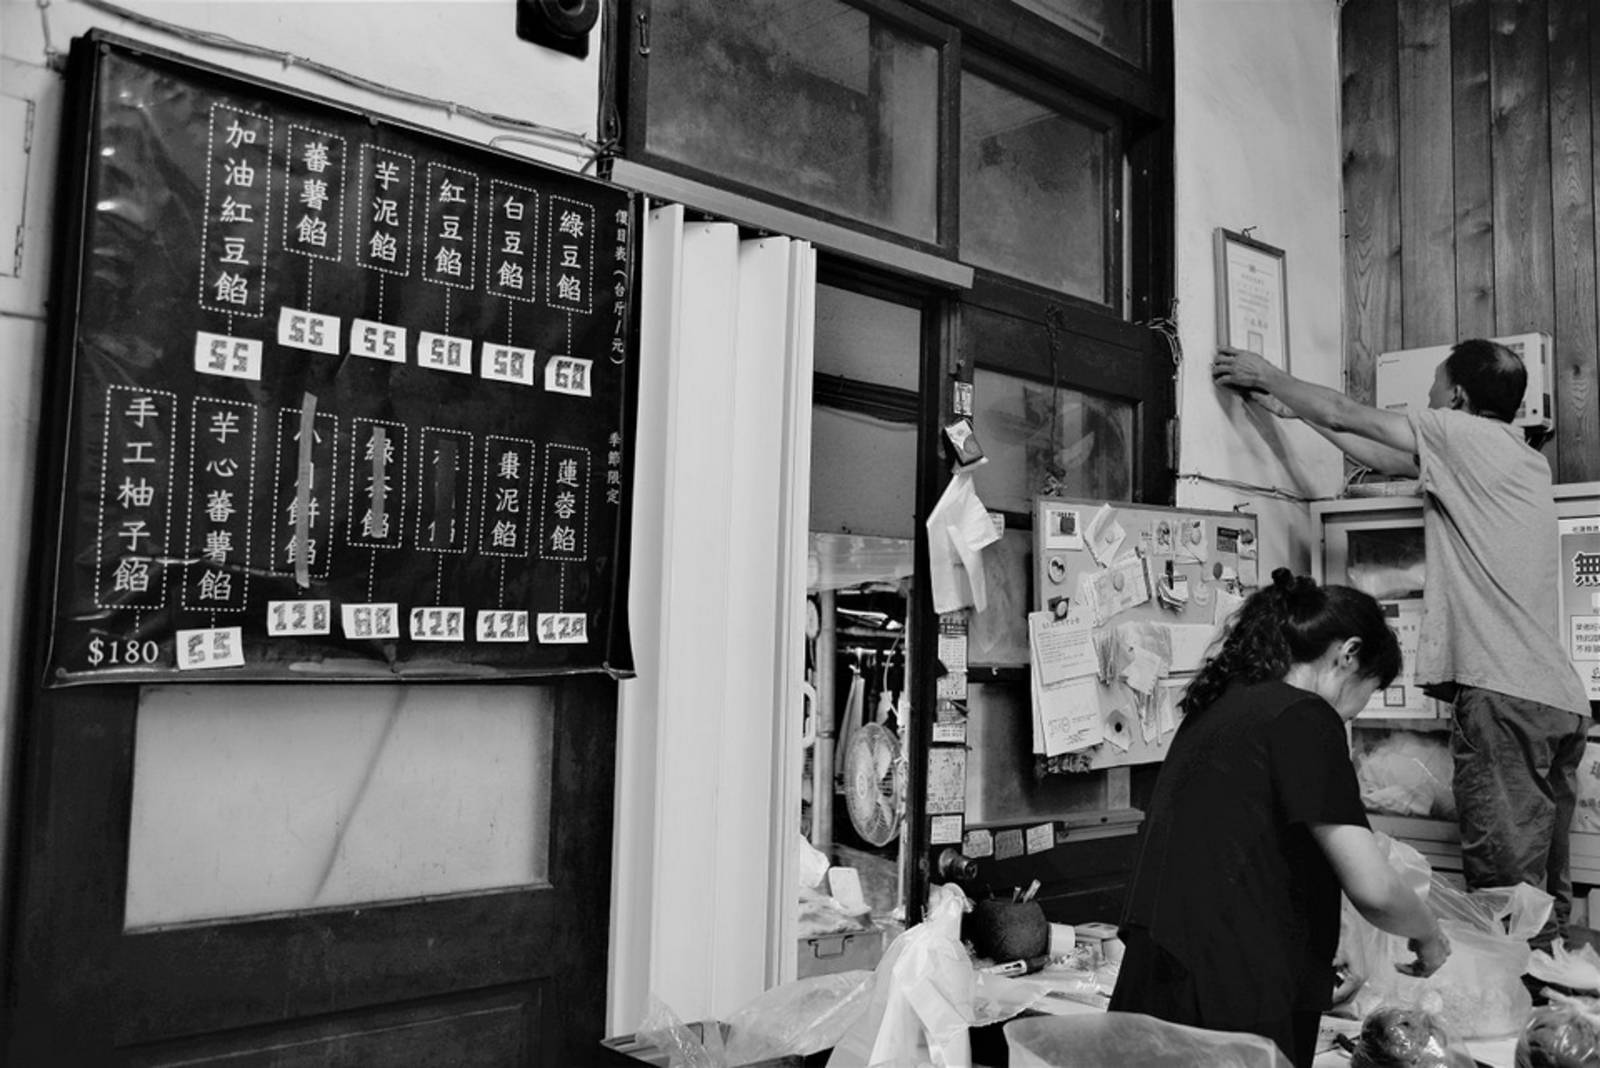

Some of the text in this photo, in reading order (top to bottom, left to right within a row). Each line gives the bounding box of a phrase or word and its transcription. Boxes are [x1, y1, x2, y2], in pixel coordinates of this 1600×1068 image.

[213, 120, 256, 305] 加油紅豆餡
[296, 142, 332, 247] 蕃薯餡
[369, 161, 400, 262] 芋泥餡
[434, 178, 466, 277] 紅豆餡
[496, 195, 525, 290] 白豆餡
[556, 209, 584, 302] 綠豆餡
[208, 338, 249, 373] 55
[289, 314, 325, 347] 55
[363, 326, 397, 357] 55
[430, 338, 462, 367] 50
[493, 349, 526, 379] 50
[112, 396, 160, 592] 手工柚子餡
[197, 411, 240, 601] 芋心蕃薯餡
[490, 450, 521, 548] 棗泥餡
[550, 458, 580, 551] 蓮蓉餡
[87, 636, 160, 666] $180
[273, 605, 328, 631] 120
